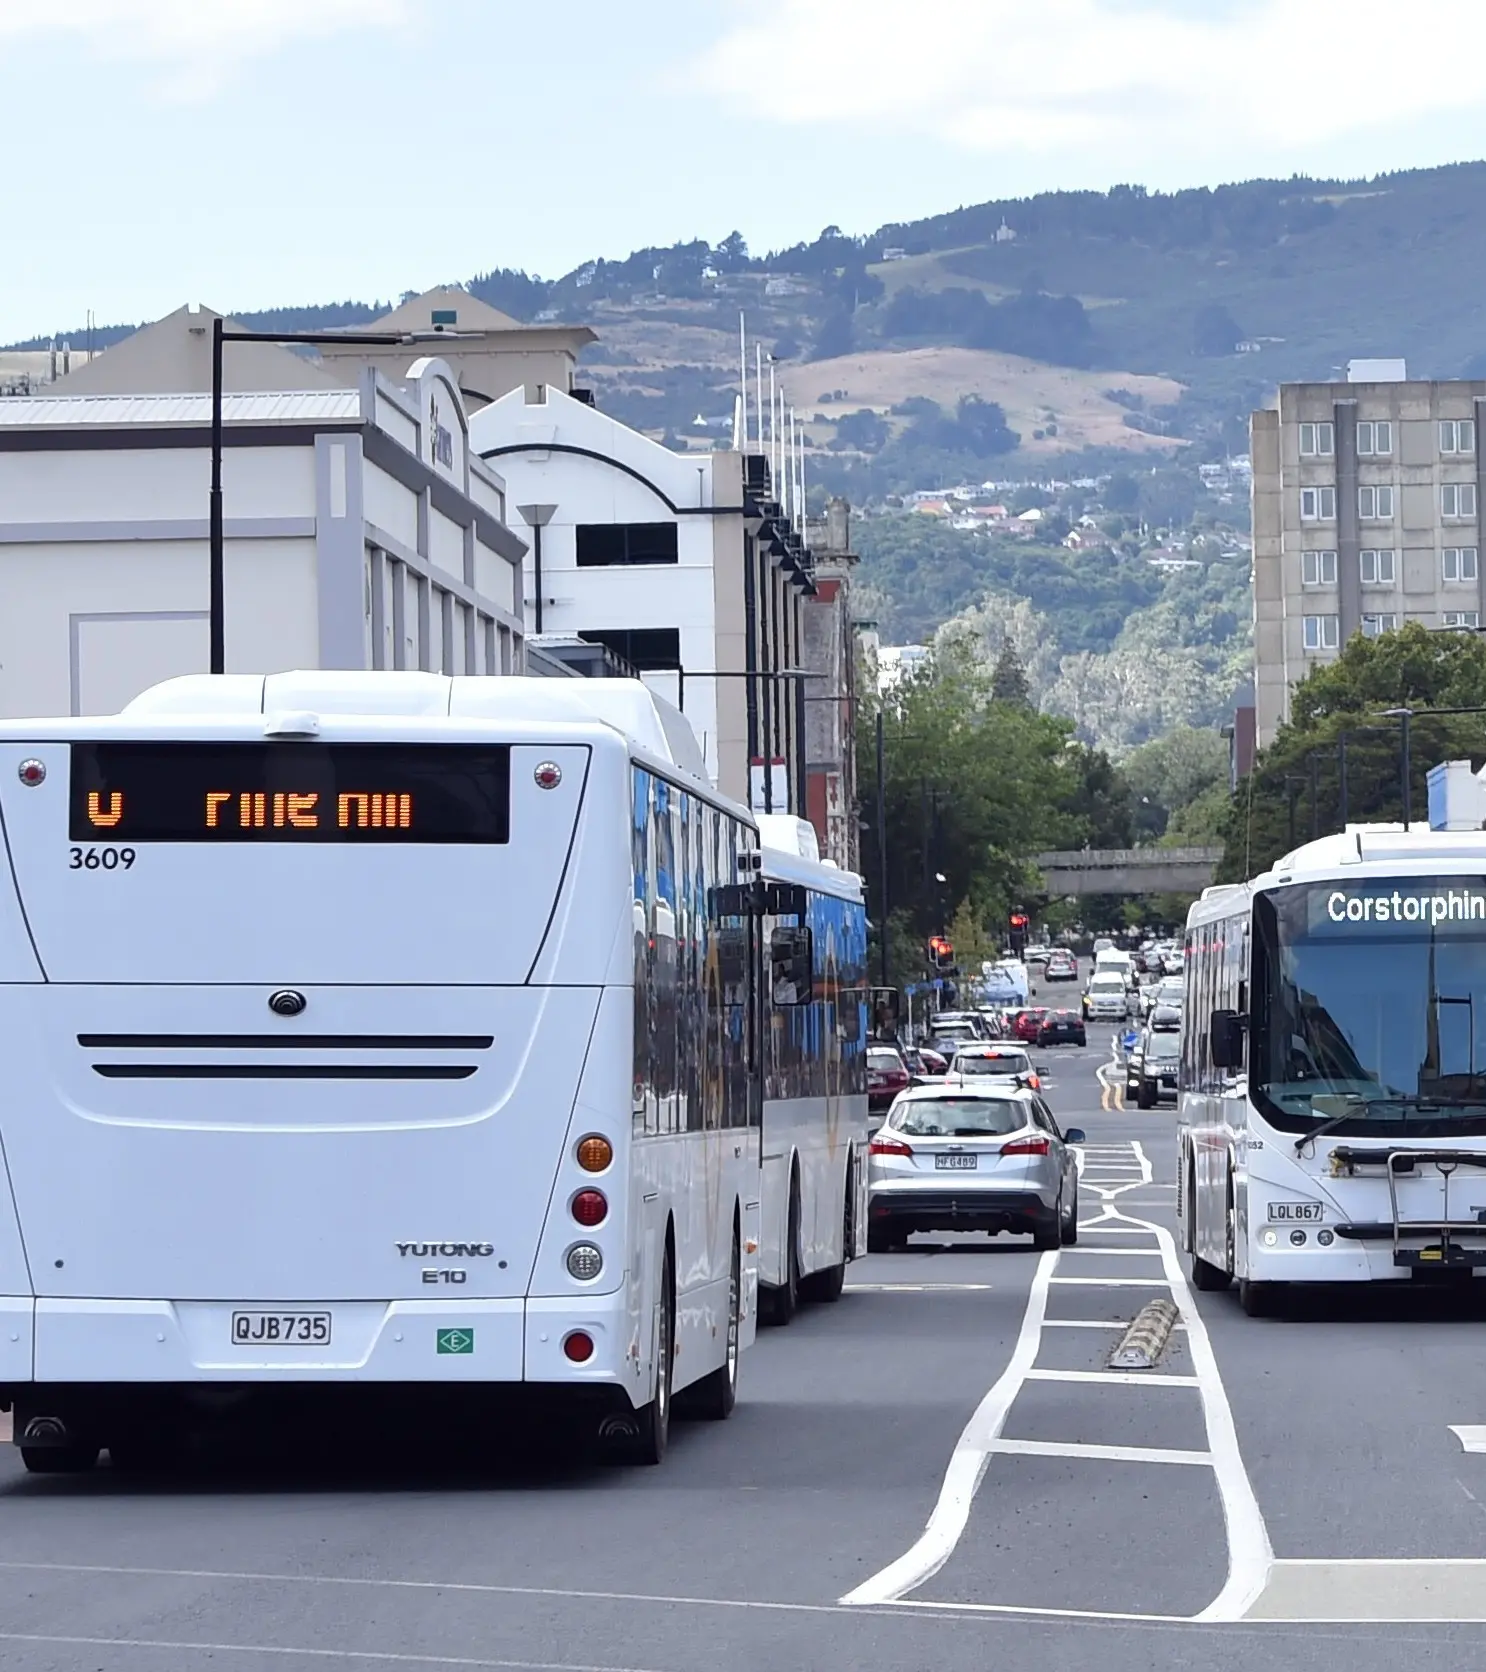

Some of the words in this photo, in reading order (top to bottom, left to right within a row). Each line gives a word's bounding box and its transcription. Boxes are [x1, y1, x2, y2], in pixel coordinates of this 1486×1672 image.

[68, 847, 137, 870] 3609
[1269, 1205, 1320, 1219] LQL867
[395, 1241, 495, 1257] YUTONG
[421, 1267, 467, 1284] E10
[236, 1316, 327, 1340] QJB735
